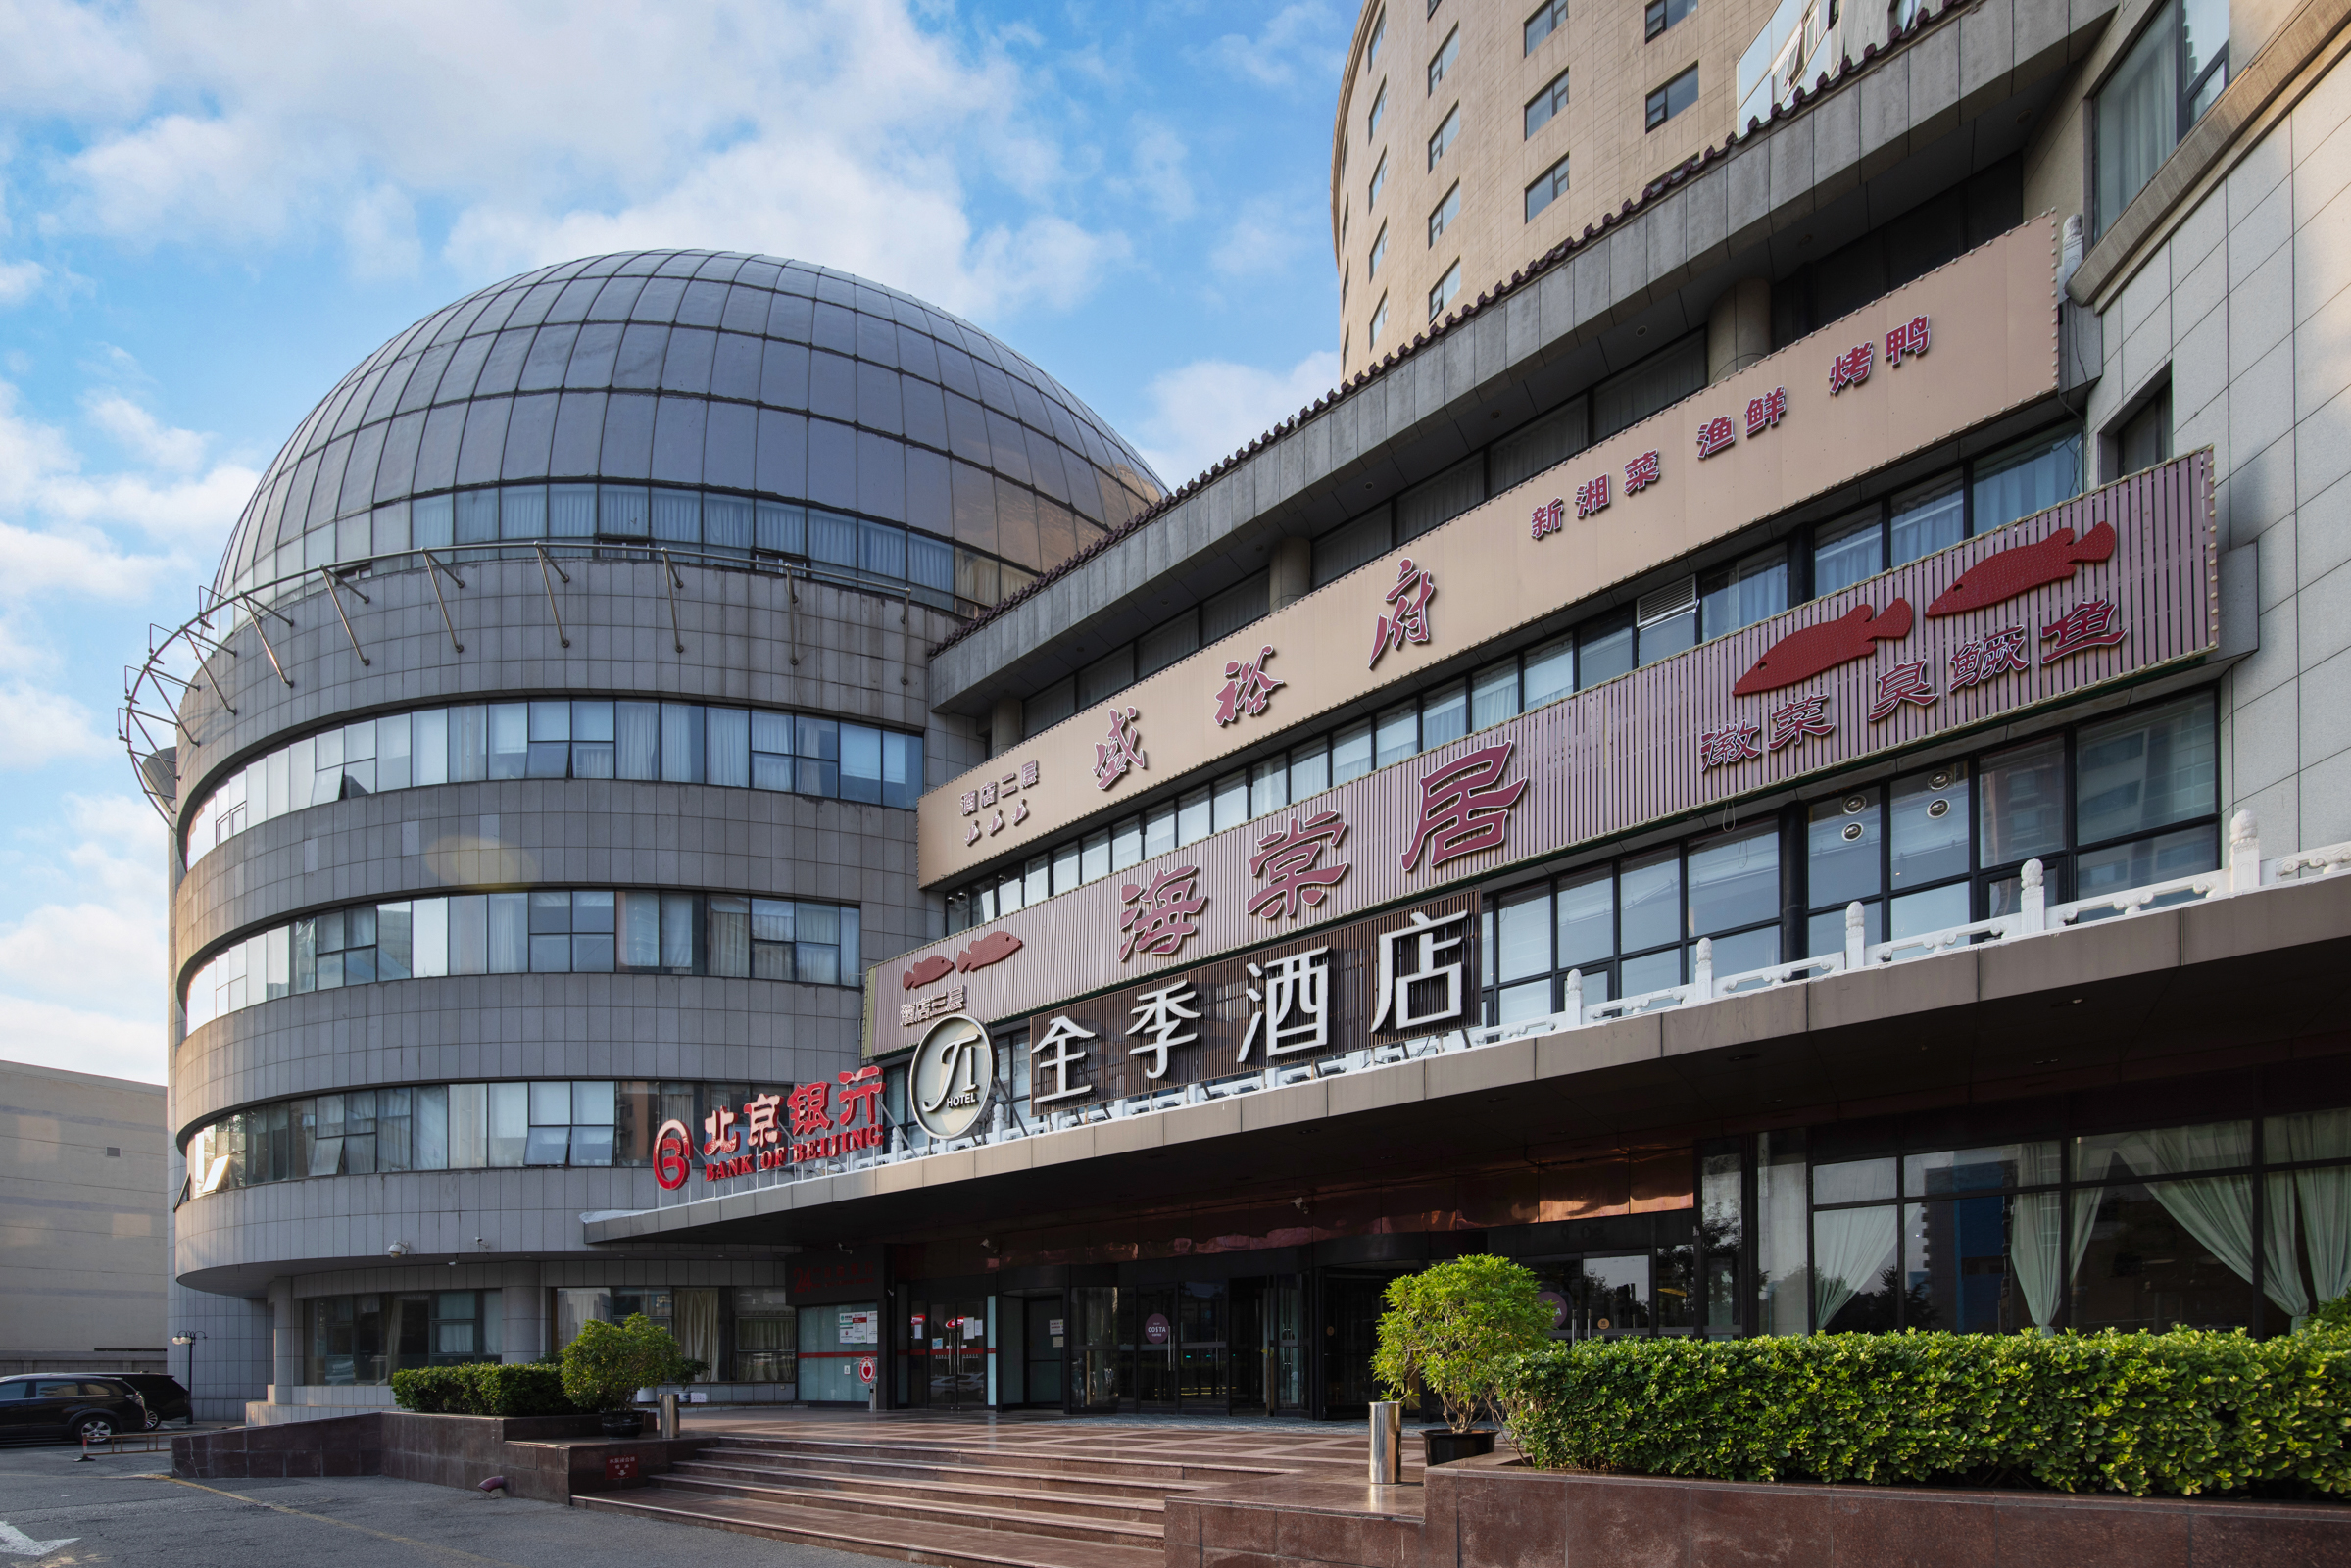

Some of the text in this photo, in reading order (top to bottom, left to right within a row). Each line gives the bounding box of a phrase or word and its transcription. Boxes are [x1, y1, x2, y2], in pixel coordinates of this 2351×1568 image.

[1530, 314, 1932, 541] 新湘菜 渔鲜 烤鸭
[1092, 557, 1437, 791] 盛裕府
[1700, 598, 2129, 772] 徽菜 臭鳜鱼
[960, 760, 1038, 816] 酒店二层
[1117, 739, 1529, 962] 海棠居
[901, 984, 966, 1026] 酒店三层
[1030, 909, 1471, 1103] 全季酒店
[704, 1065, 886, 1156] 北京银行
[946, 1092, 979, 1108] HOTEL
[705, 1124, 884, 1182] BANK OF BEIJING
[793, 1265, 813, 1293] 24
